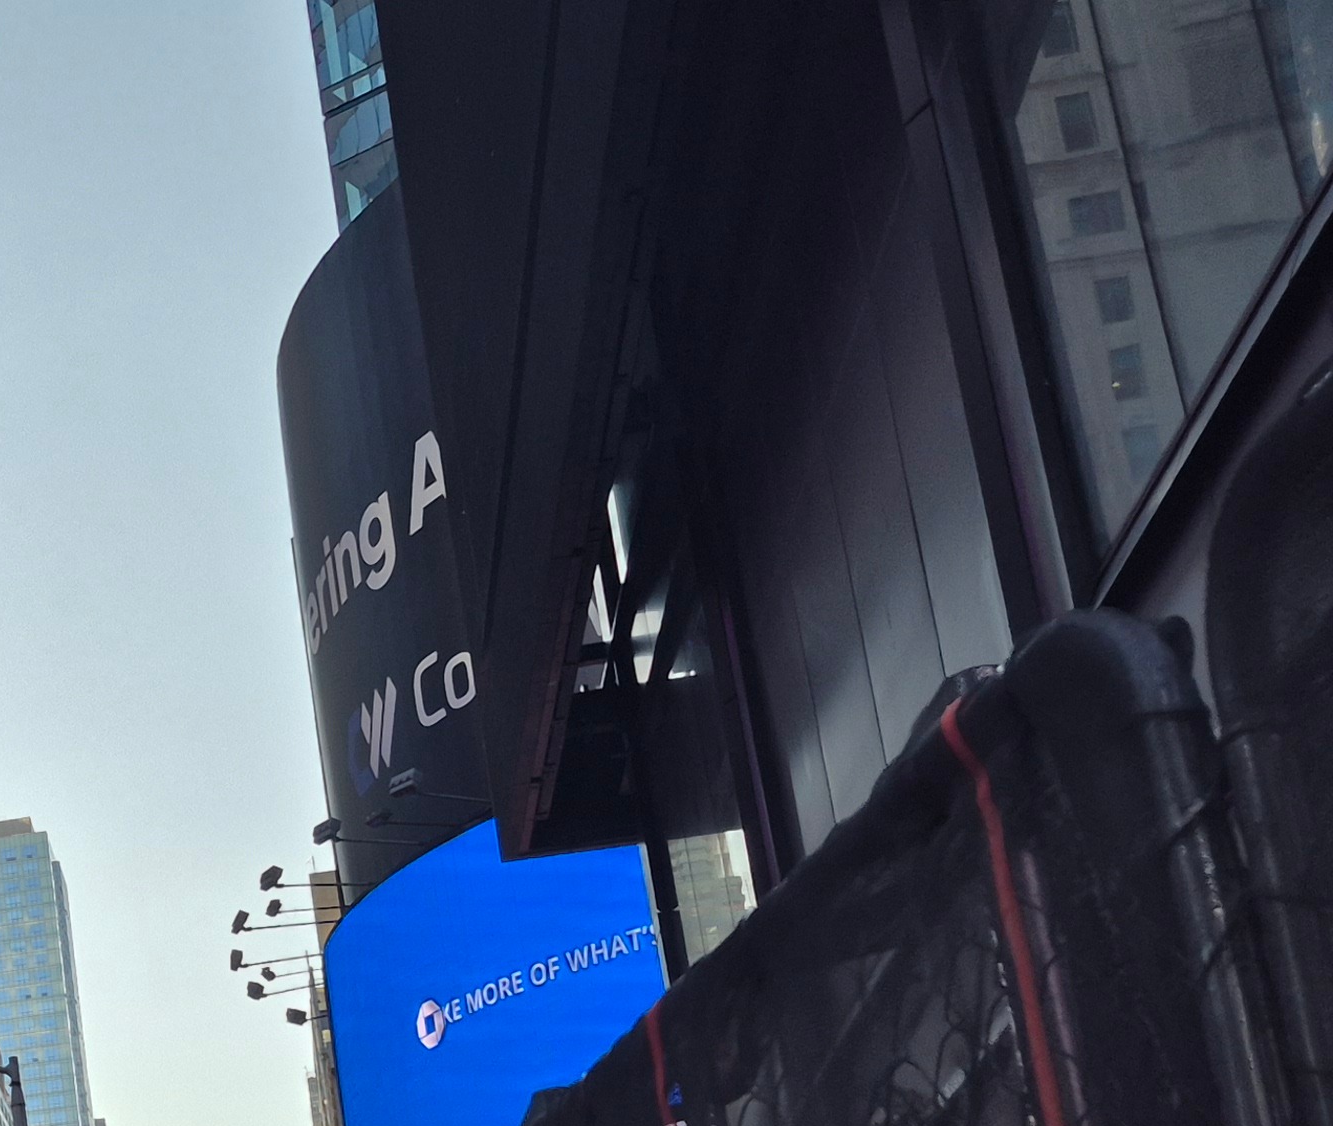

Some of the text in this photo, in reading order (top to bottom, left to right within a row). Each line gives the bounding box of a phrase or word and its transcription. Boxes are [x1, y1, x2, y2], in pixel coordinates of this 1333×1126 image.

[409, 430, 447, 536] A
[465, 971, 525, 1014] MORE
[530, 956, 561, 987] OF
